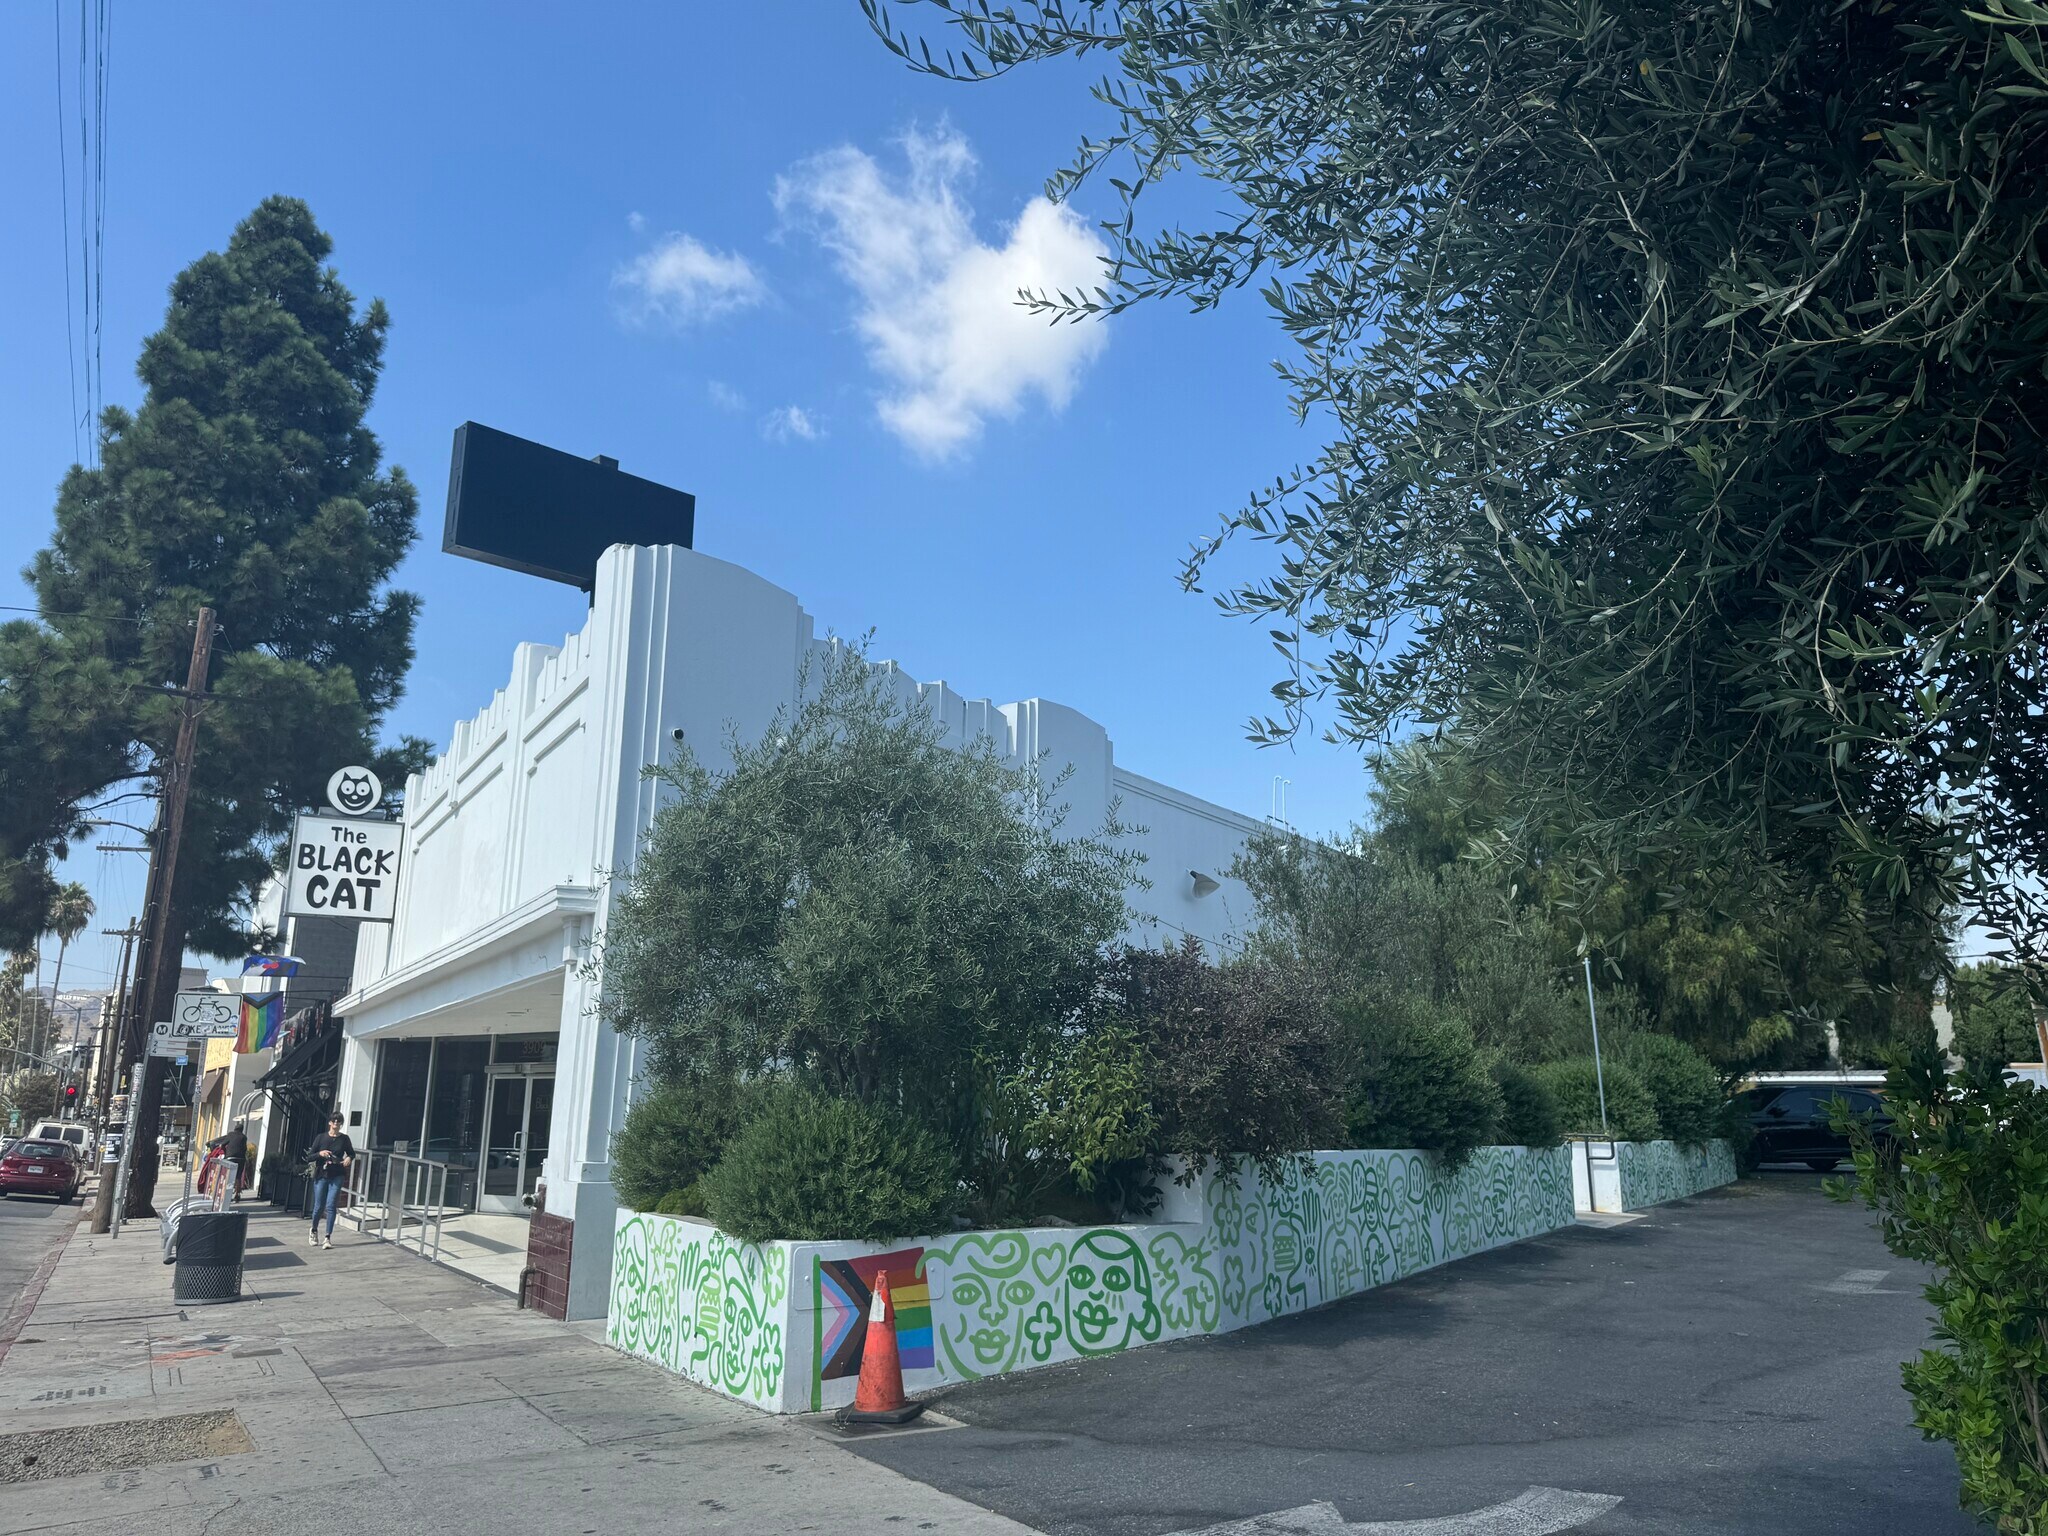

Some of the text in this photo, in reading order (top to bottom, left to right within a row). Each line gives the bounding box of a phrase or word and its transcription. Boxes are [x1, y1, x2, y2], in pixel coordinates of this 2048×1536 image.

[331, 826, 367, 844] The
[297, 843, 395, 876] BLACK
[306, 874, 382, 912] CAT
[522, 1039, 545, 1054] 3909
